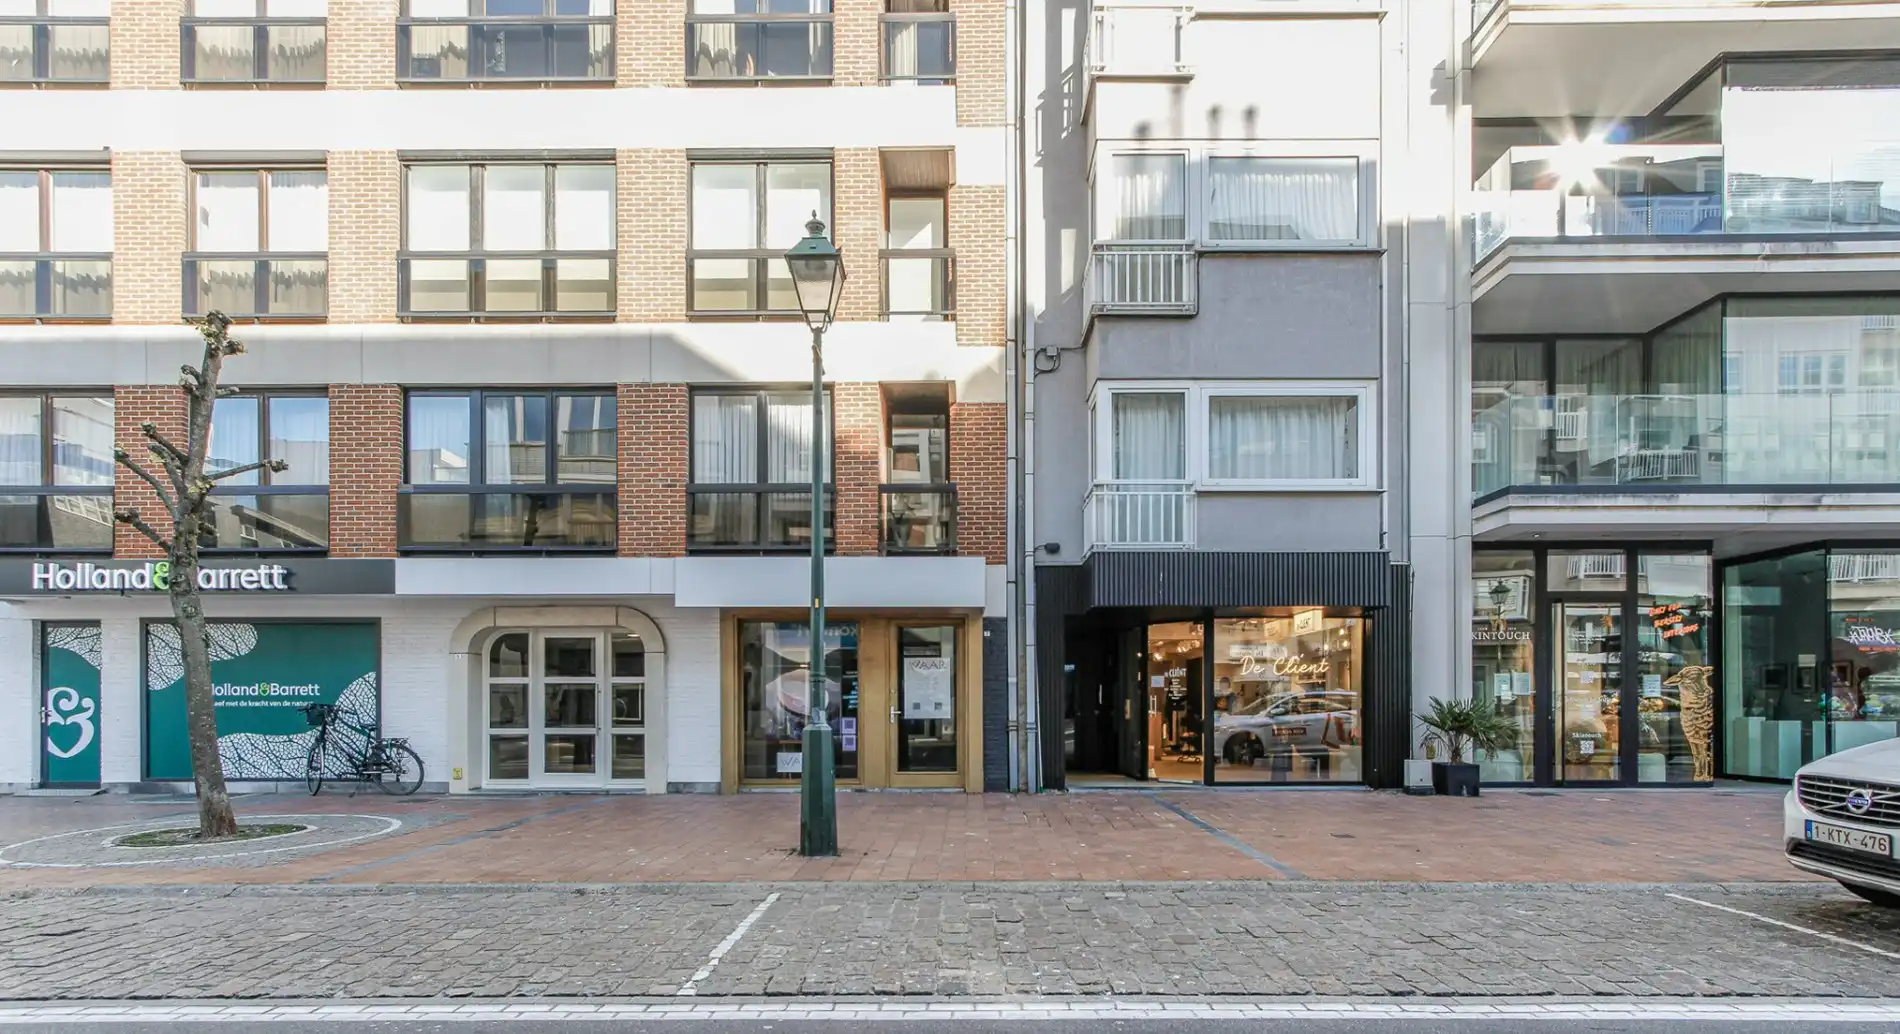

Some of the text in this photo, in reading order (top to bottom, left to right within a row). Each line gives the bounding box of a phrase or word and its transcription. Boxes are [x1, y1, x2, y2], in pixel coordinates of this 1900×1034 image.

[32, 561, 289, 590] Holland&arrett
[1472, 631, 1530, 640] KINTOUCH
[1240, 655, 1265, 676] De
[1815, 825, 1887, 852] 1-KTX-476
